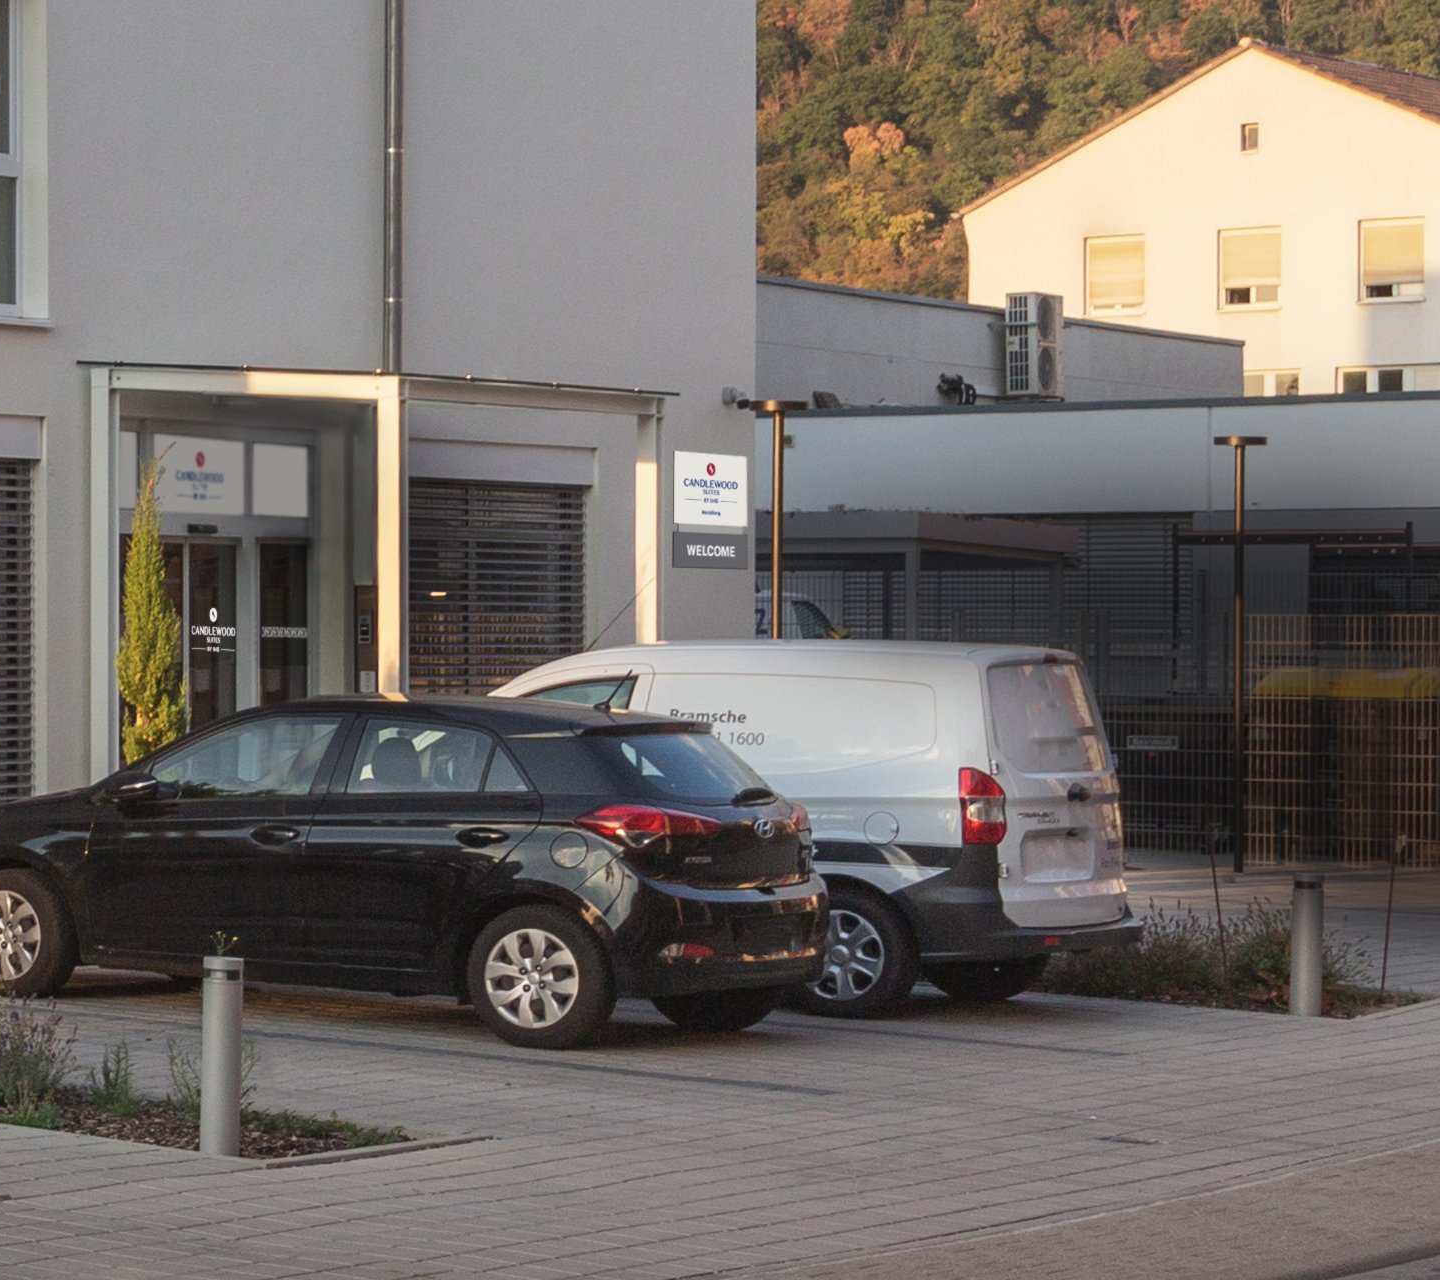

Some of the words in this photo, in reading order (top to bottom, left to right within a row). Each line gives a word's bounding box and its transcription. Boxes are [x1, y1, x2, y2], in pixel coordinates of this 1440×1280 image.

[683, 478, 738, 489] CANDLEWOOD
[687, 544, 736, 557] WELCOME
[191, 625, 236, 637] CANDLEWOOD
[729, 731, 765, 745] 1600
